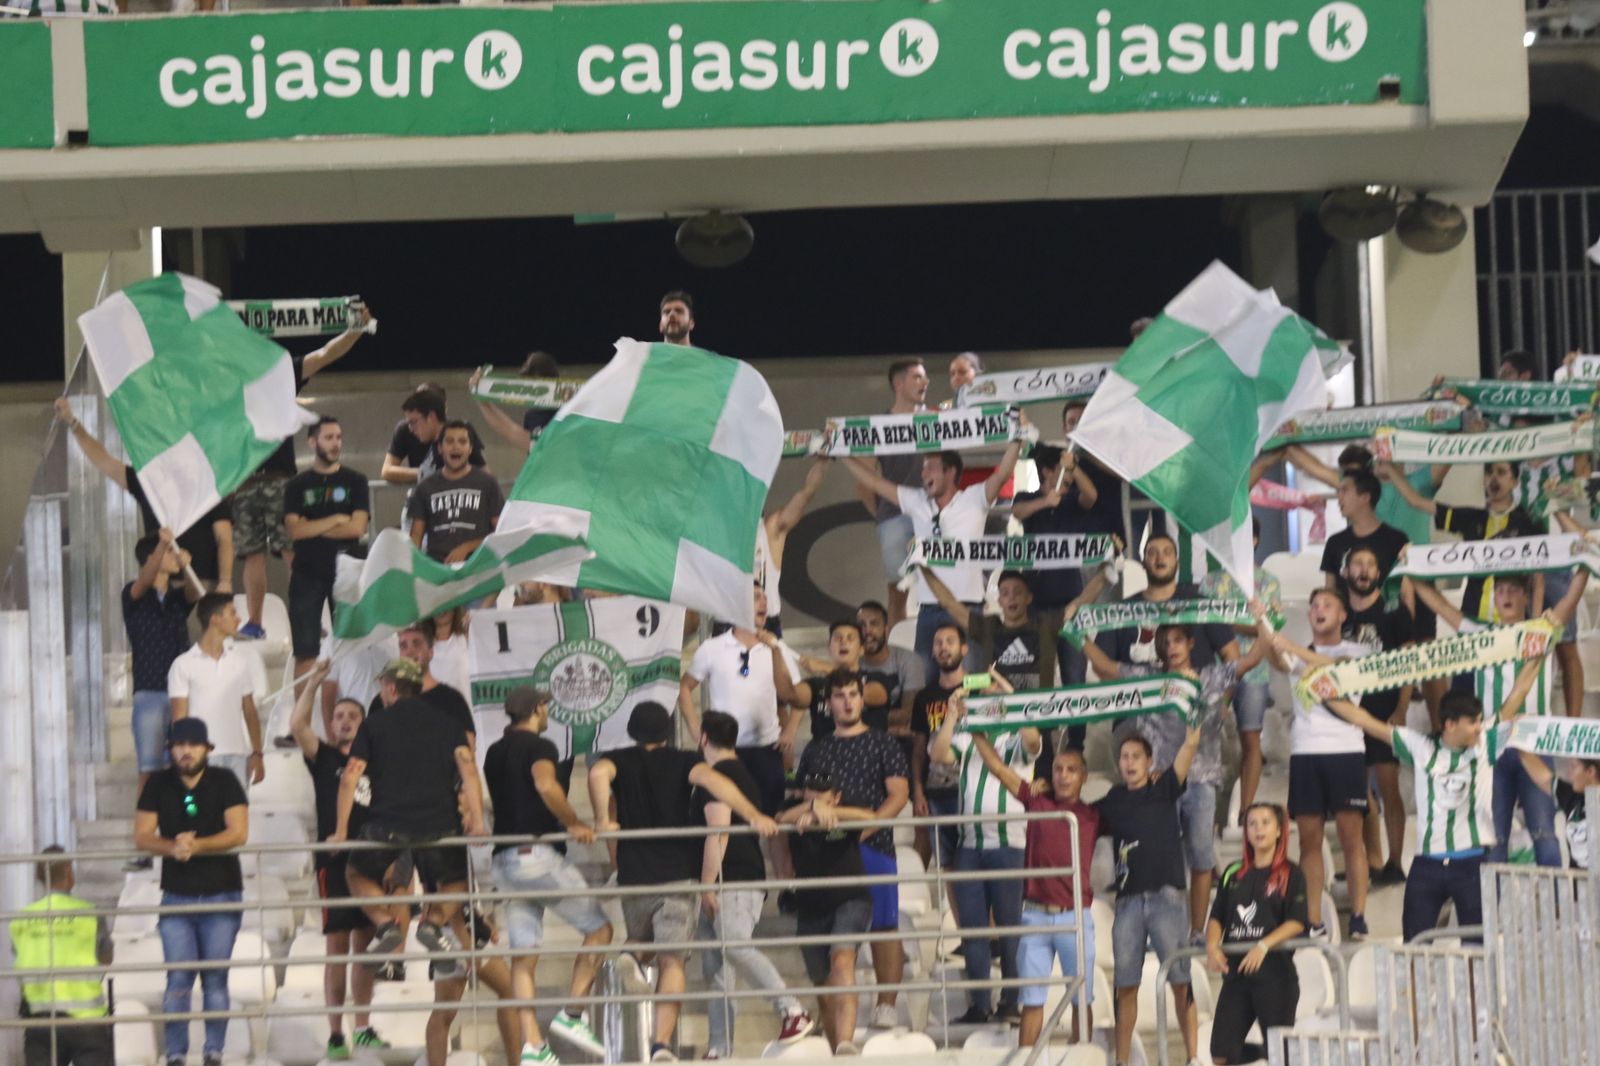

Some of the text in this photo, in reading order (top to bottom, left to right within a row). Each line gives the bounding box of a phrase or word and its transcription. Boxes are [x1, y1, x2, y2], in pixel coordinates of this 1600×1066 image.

[1003, 9, 1299, 92] cajasur
[159, 35, 454, 120] cajasur
[577, 23, 869, 109] cajasur
[267, 308, 309, 328] PARA
[313, 306, 346, 326] MAL
[1479, 384, 1572, 406] CÓRDOBA
[843, 425, 881, 446] PARA
[883, 423, 917, 444] BIEN
[933, 418, 973, 440] PARA
[975, 414, 1008, 437] MAL
[922, 539, 965, 560] PARA
[969, 538, 1008, 561] BIEN
[1025, 539, 1068, 560] PARA
[1074, 536, 1107, 558] MAL
[1427, 540, 1549, 565] CÓRDOBA
[542, 639, 617, 667] BRIGADAS
[1023, 688, 1143, 720] CÓRDOBA
